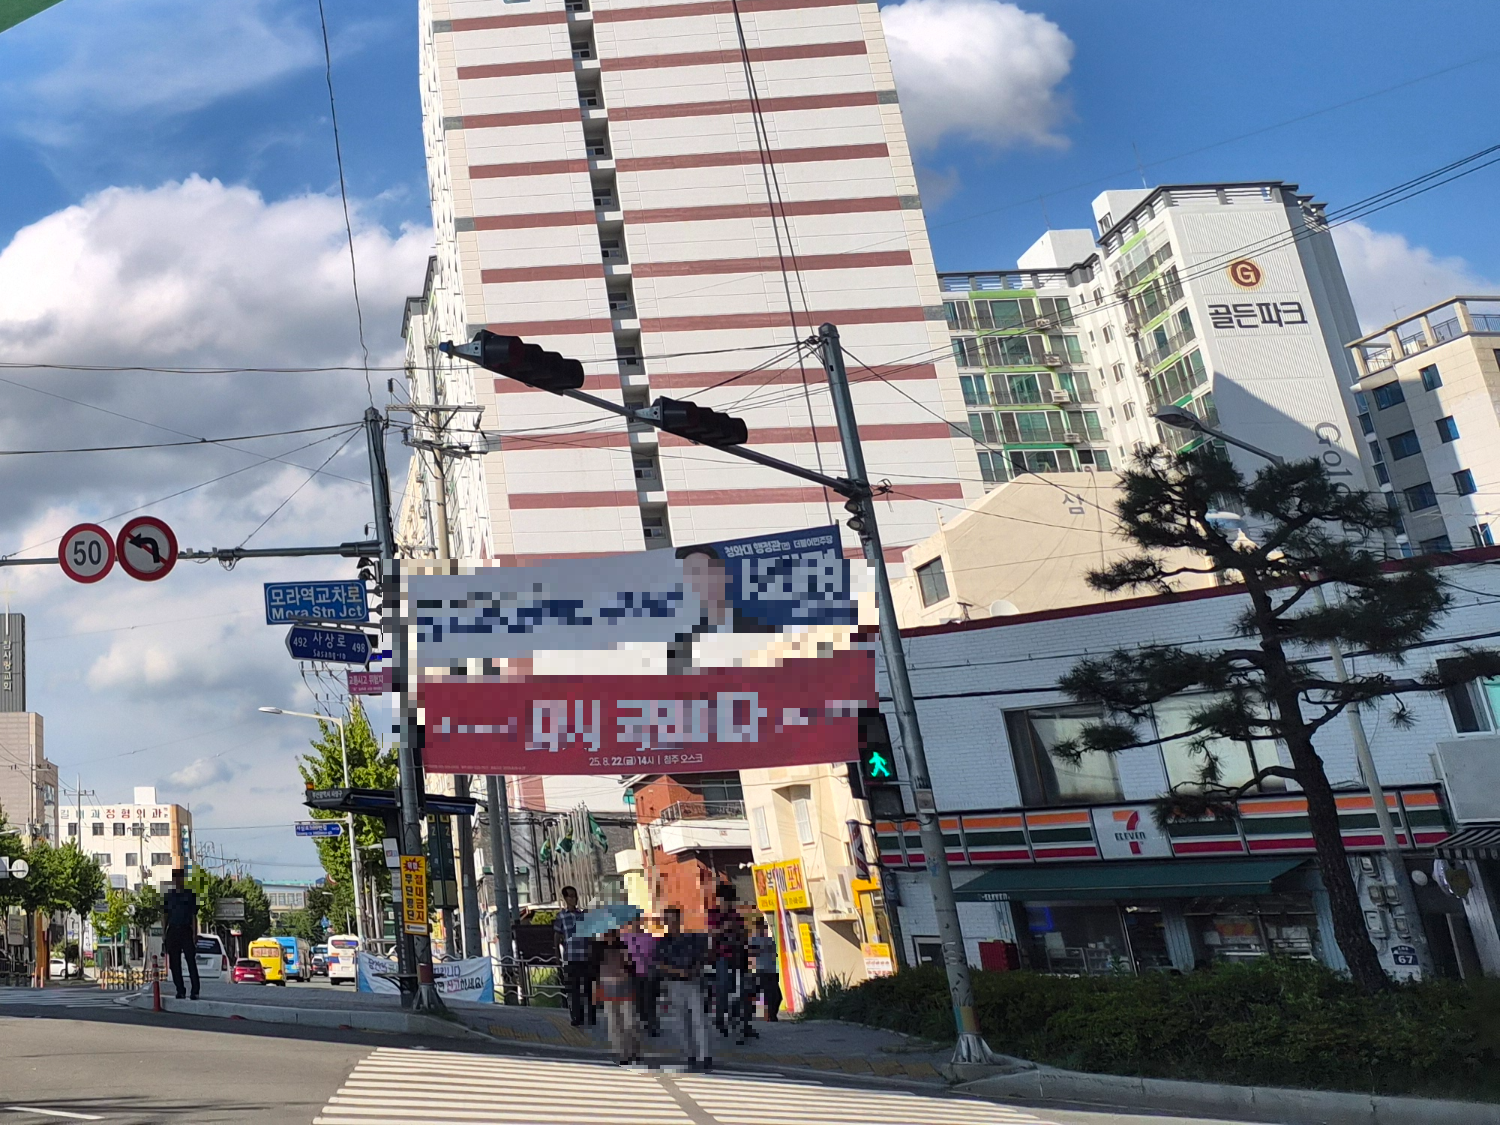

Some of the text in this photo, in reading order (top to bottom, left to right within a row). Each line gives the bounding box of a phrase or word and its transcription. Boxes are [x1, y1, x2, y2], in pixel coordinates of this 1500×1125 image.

[1208, 301, 1308, 329] 골든파크
[73, 539, 102, 567] 50
[724, 543, 754, 558] 청와대
[793, 535, 833, 549] 더불어민주당
[270, 584, 363, 606] 모라역교차로
[272, 604, 363, 620] Mora Stn Jct
[293, 631, 366, 653] 492 사상로 498
[312, 648, 347, 660] Sasang-ro
[680, 753, 703, 764] 오스코
[106, 808, 162, 819] 정형외과
[414, 874, 425, 922] 절대금지
[1397, 955, 1414, 965] 67
